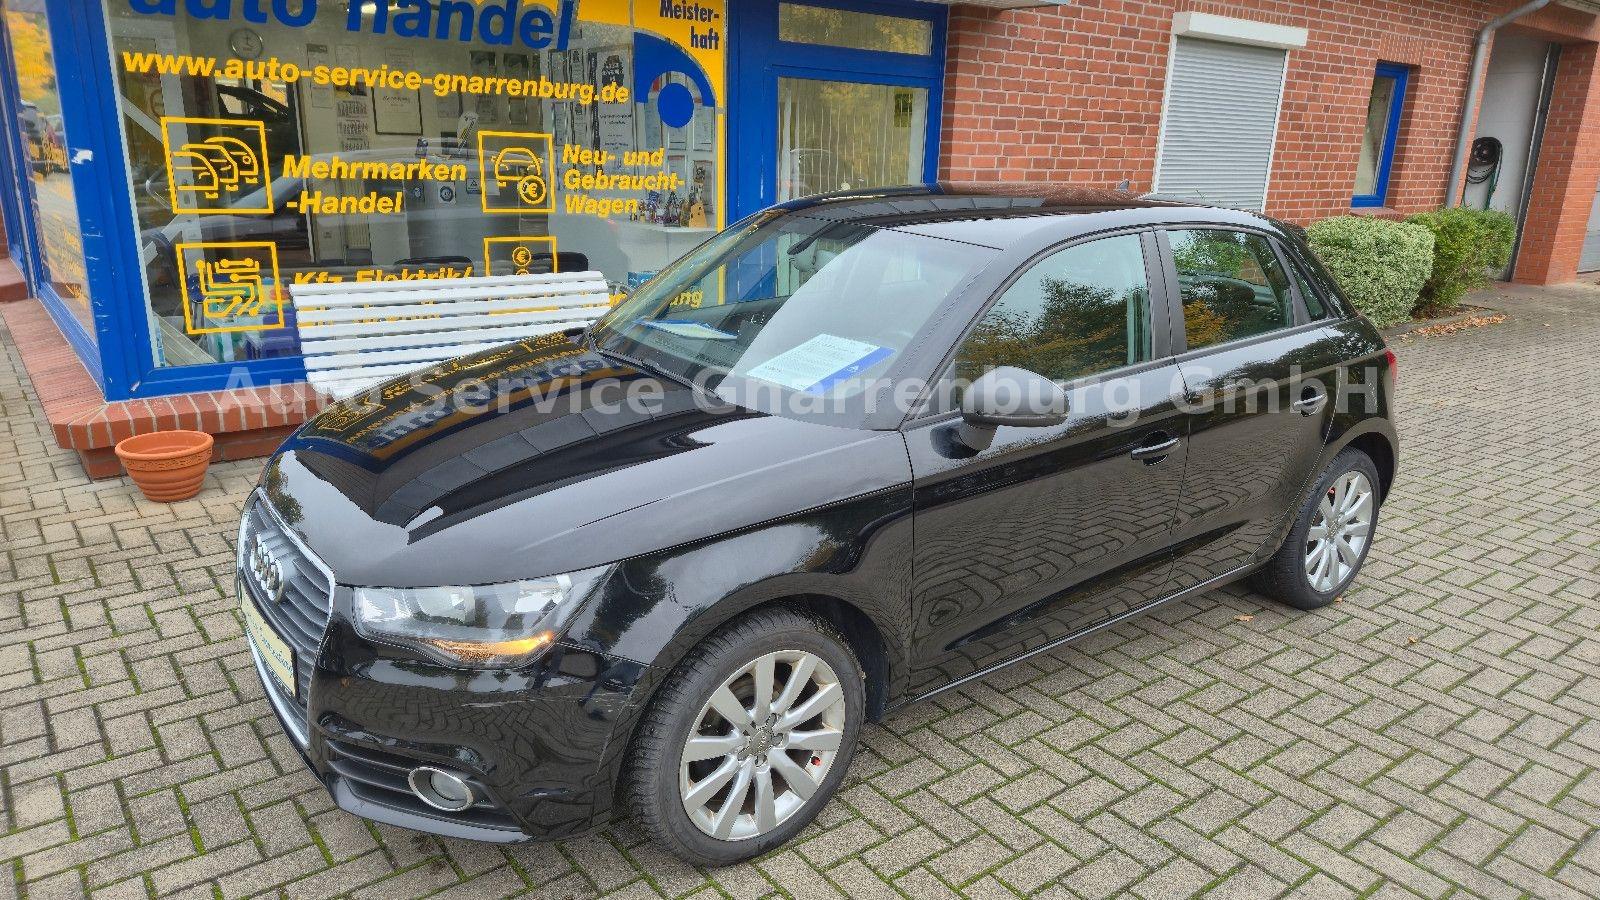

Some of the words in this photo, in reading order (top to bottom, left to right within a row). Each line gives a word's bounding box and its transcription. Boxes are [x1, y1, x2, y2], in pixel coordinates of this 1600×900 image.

[660, 0, 720, 22] Meister-
[346, 0, 573, 50] handel
[690, 26, 719, 50] haft
[123, 51, 629, 104] www.auto-service-gnarrenburg.de
[562, 144, 616, 166] Neu-
[624, 147, 665, 167] und
[283, 155, 467, 181] Mehrmarken
[564, 168, 685, 191] Gebraucht-
[287, 191, 403, 214] -Handel
[565, 194, 637, 218] Wagen
